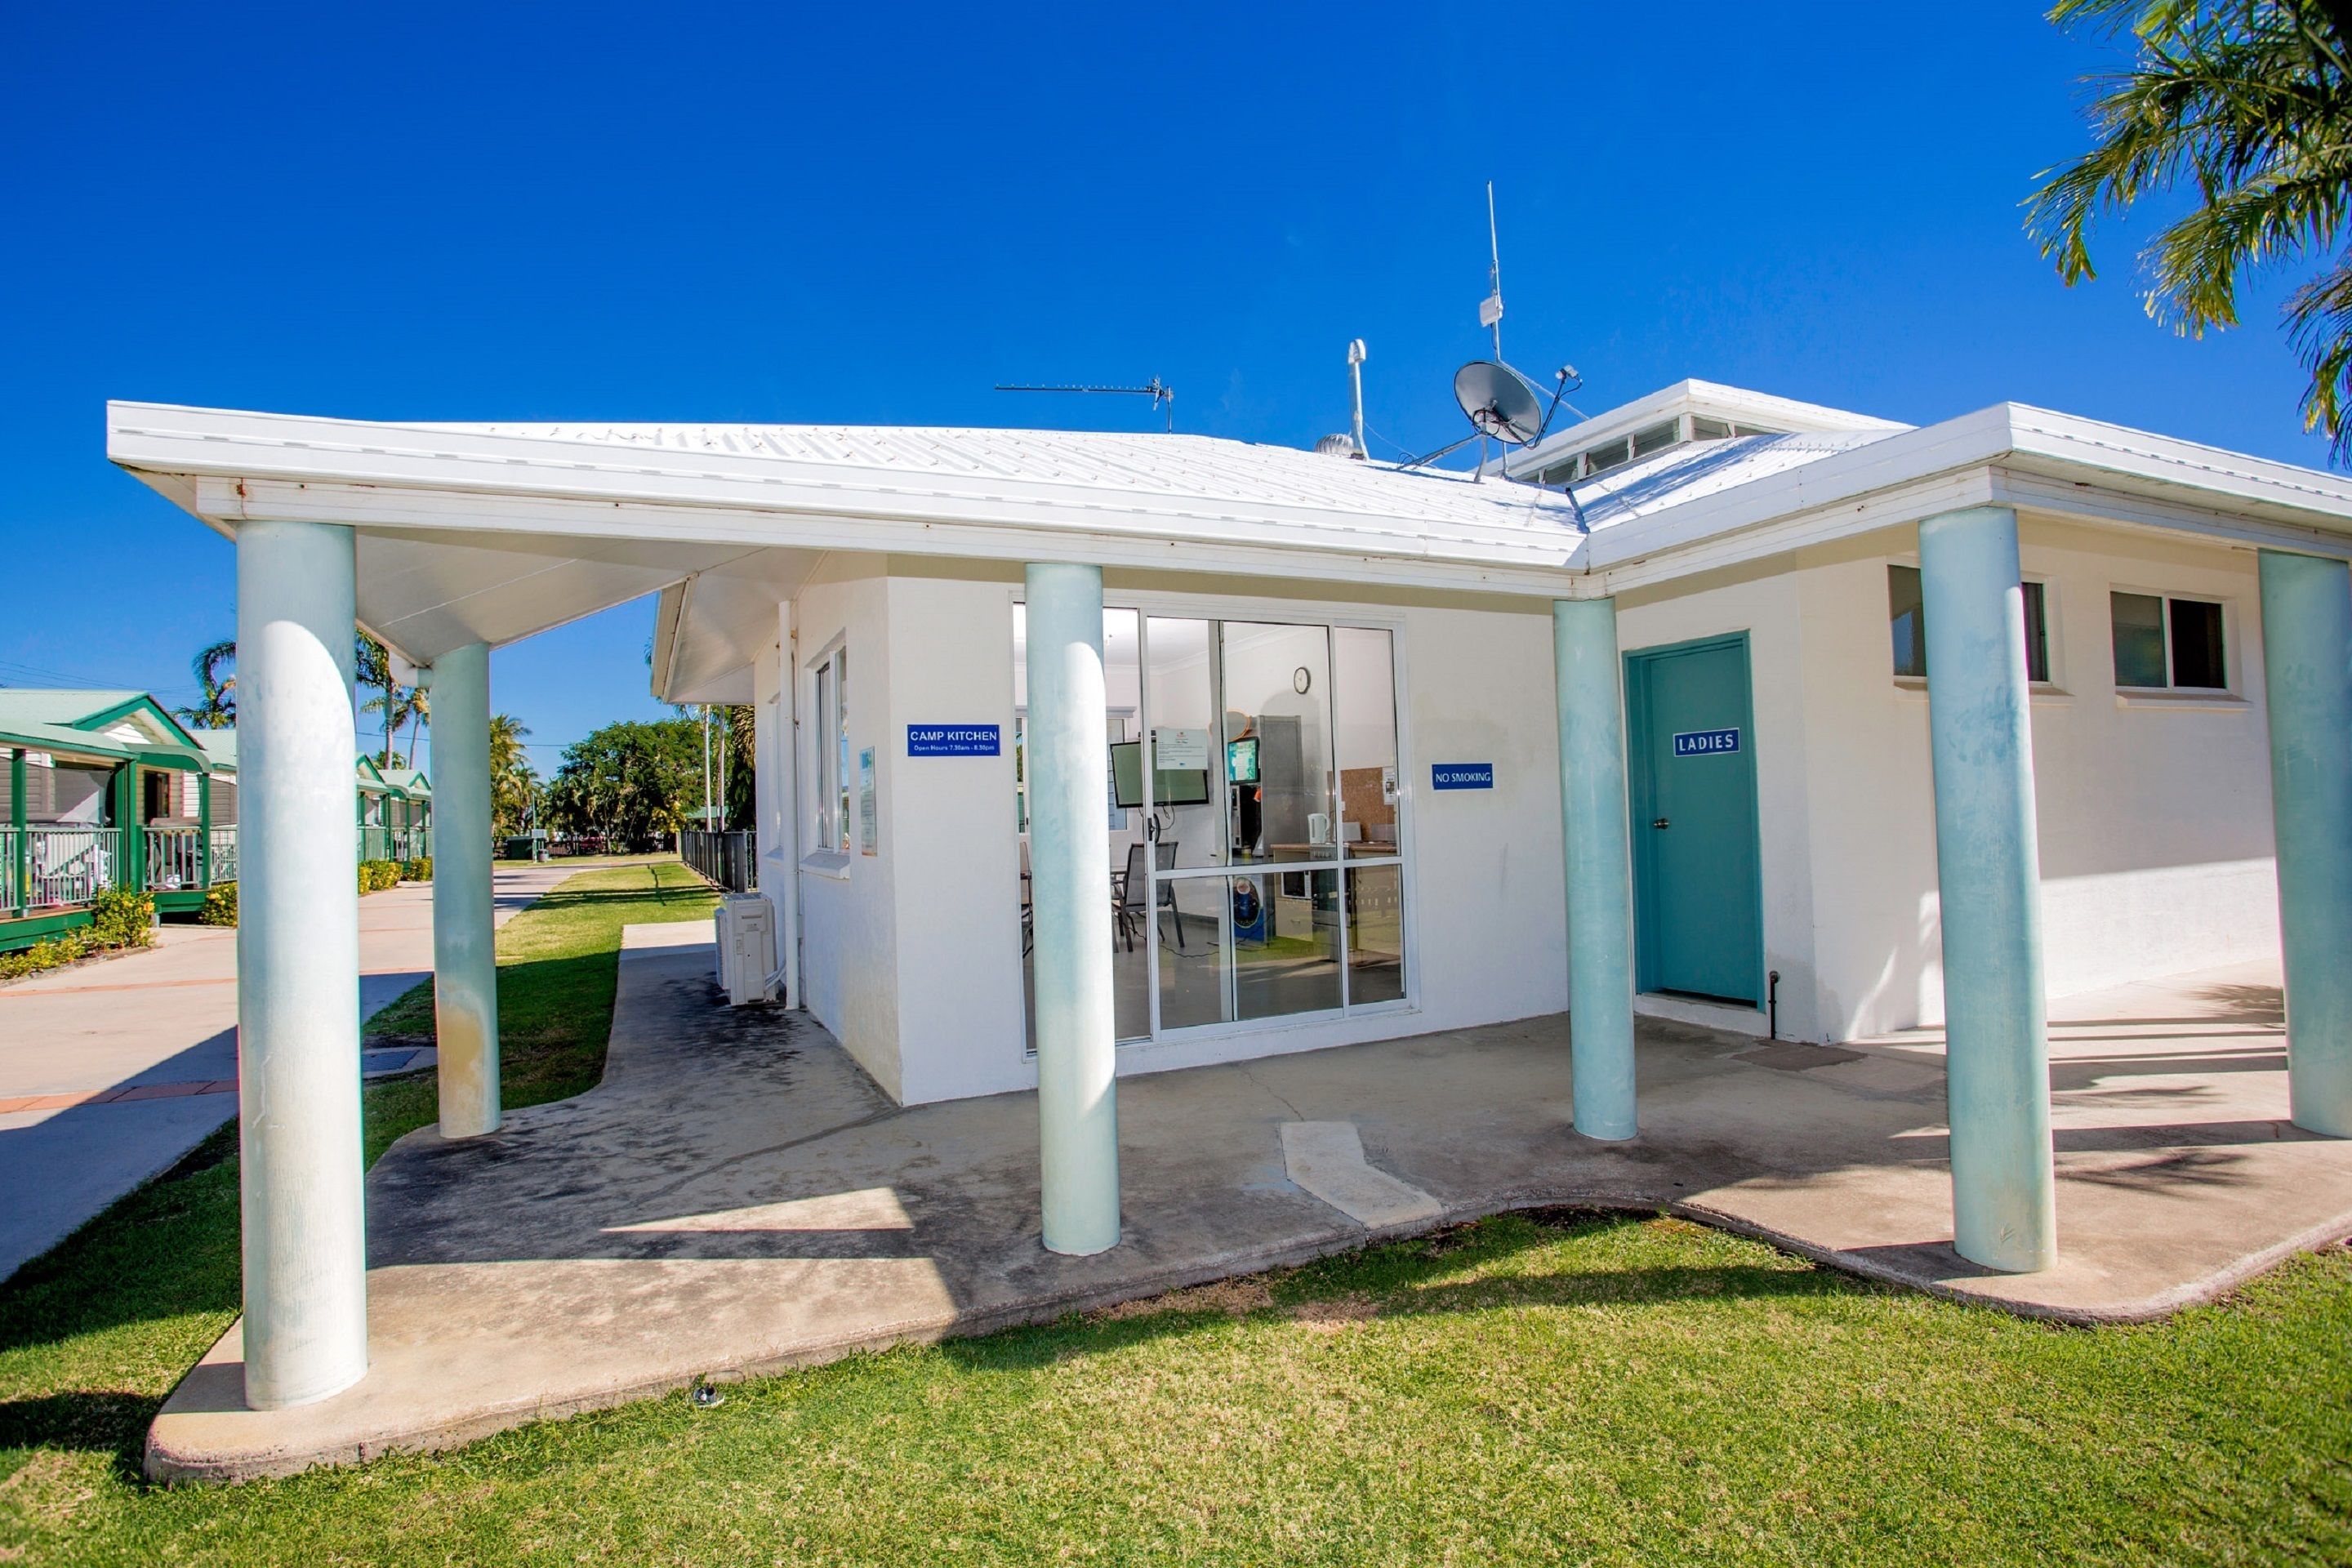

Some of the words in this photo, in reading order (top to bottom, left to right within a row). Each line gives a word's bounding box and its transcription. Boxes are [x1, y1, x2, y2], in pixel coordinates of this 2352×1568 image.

[910, 731, 944, 741] CAMP
[947, 731, 997, 741] KITCHEN
[1678, 733, 1734, 751] LADIES
[1436, 773, 1450, 782] NO
[1451, 772, 1491, 782] SMOKING
